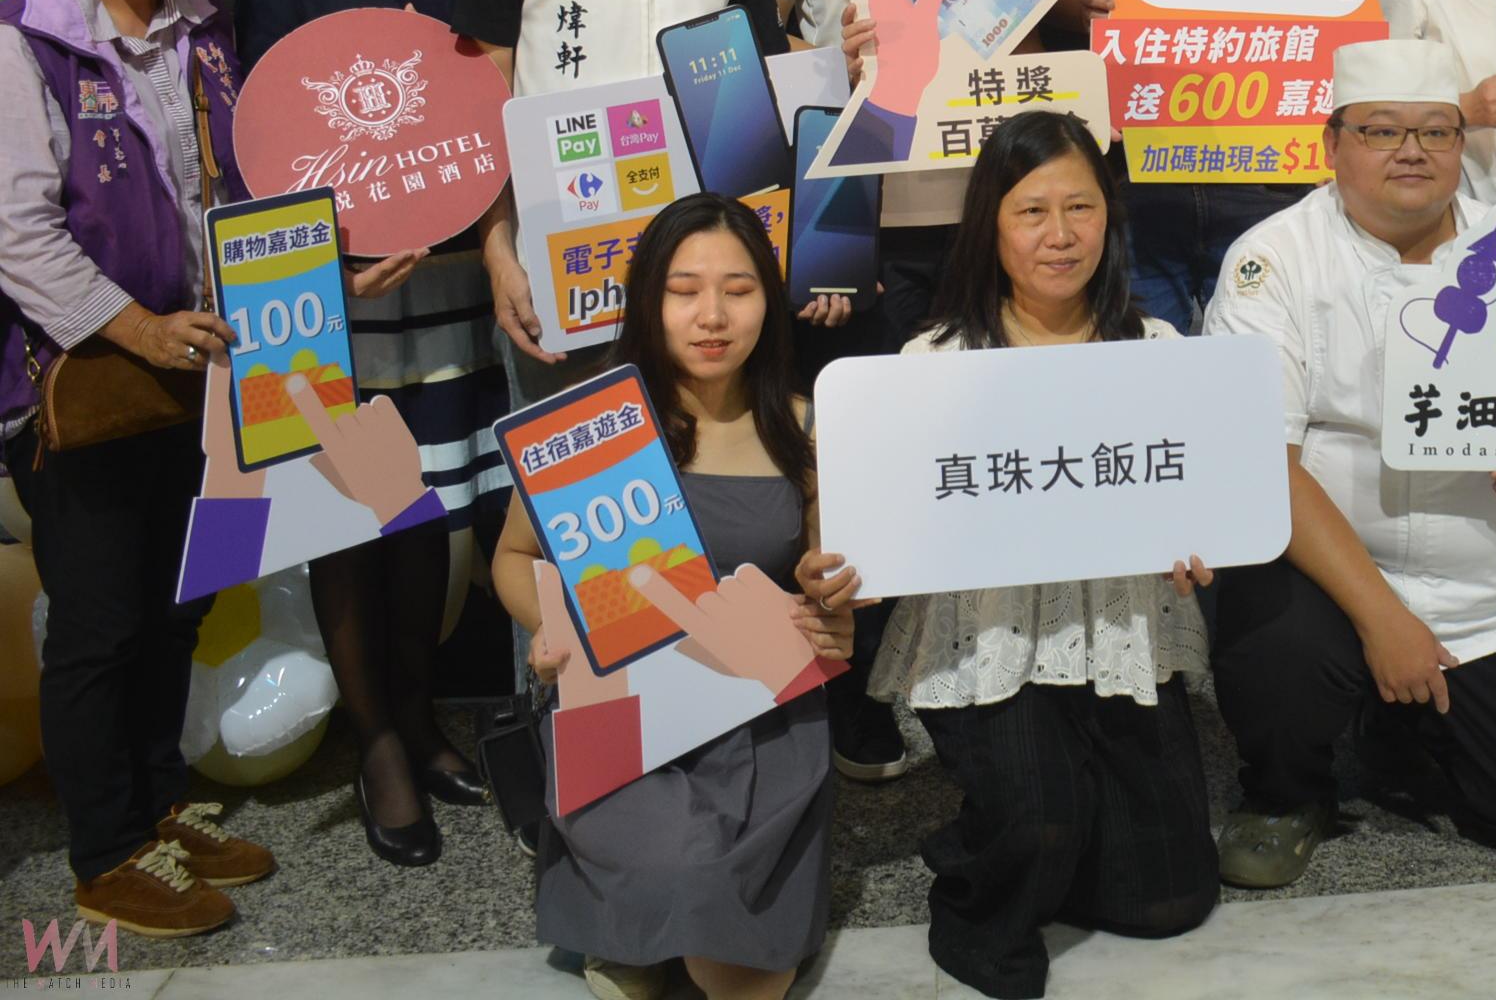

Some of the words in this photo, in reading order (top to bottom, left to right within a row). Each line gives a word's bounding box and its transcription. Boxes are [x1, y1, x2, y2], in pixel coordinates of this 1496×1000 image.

[981, 17, 1008, 48] 1000
[1100, 26, 1320, 66] 入住特約旅館
[689, 48, 737, 74] 11:11
[693, 73, 717, 85] Friday
[728, 65, 742, 73] Dec
[968, 65, 1053, 107] 特獎
[555, 113, 597, 134] LINE
[284, 144, 394, 195] Hsin
[395, 131, 491, 170] HOTEL
[560, 138, 597, 156] Pay
[626, 166, 660, 184] 全支付
[579, 200, 600, 212] Pay
[222, 221, 331, 266] 購物嘉遊金
[568, 278, 625, 321] Iph
[520, 402, 644, 475] 住宿嘉遊金
[934, 437, 1187, 501] 真珠大飯店
